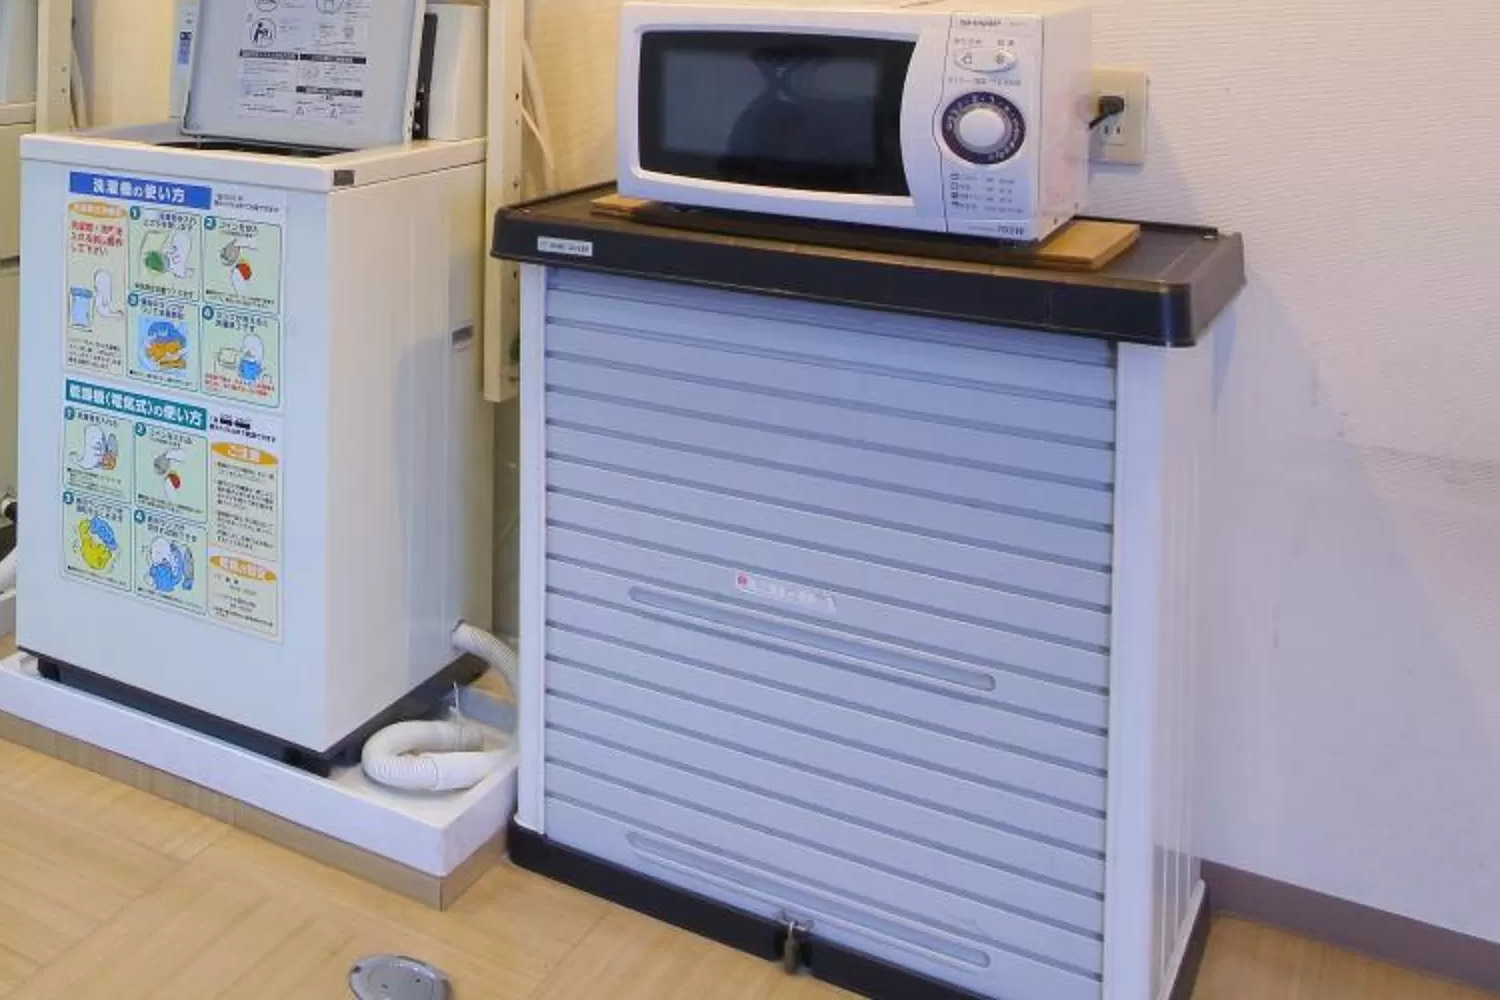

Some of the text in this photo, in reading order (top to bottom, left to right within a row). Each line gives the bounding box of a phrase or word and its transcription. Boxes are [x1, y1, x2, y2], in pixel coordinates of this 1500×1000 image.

[92, 177, 186, 204] 洗濯機の使い方
